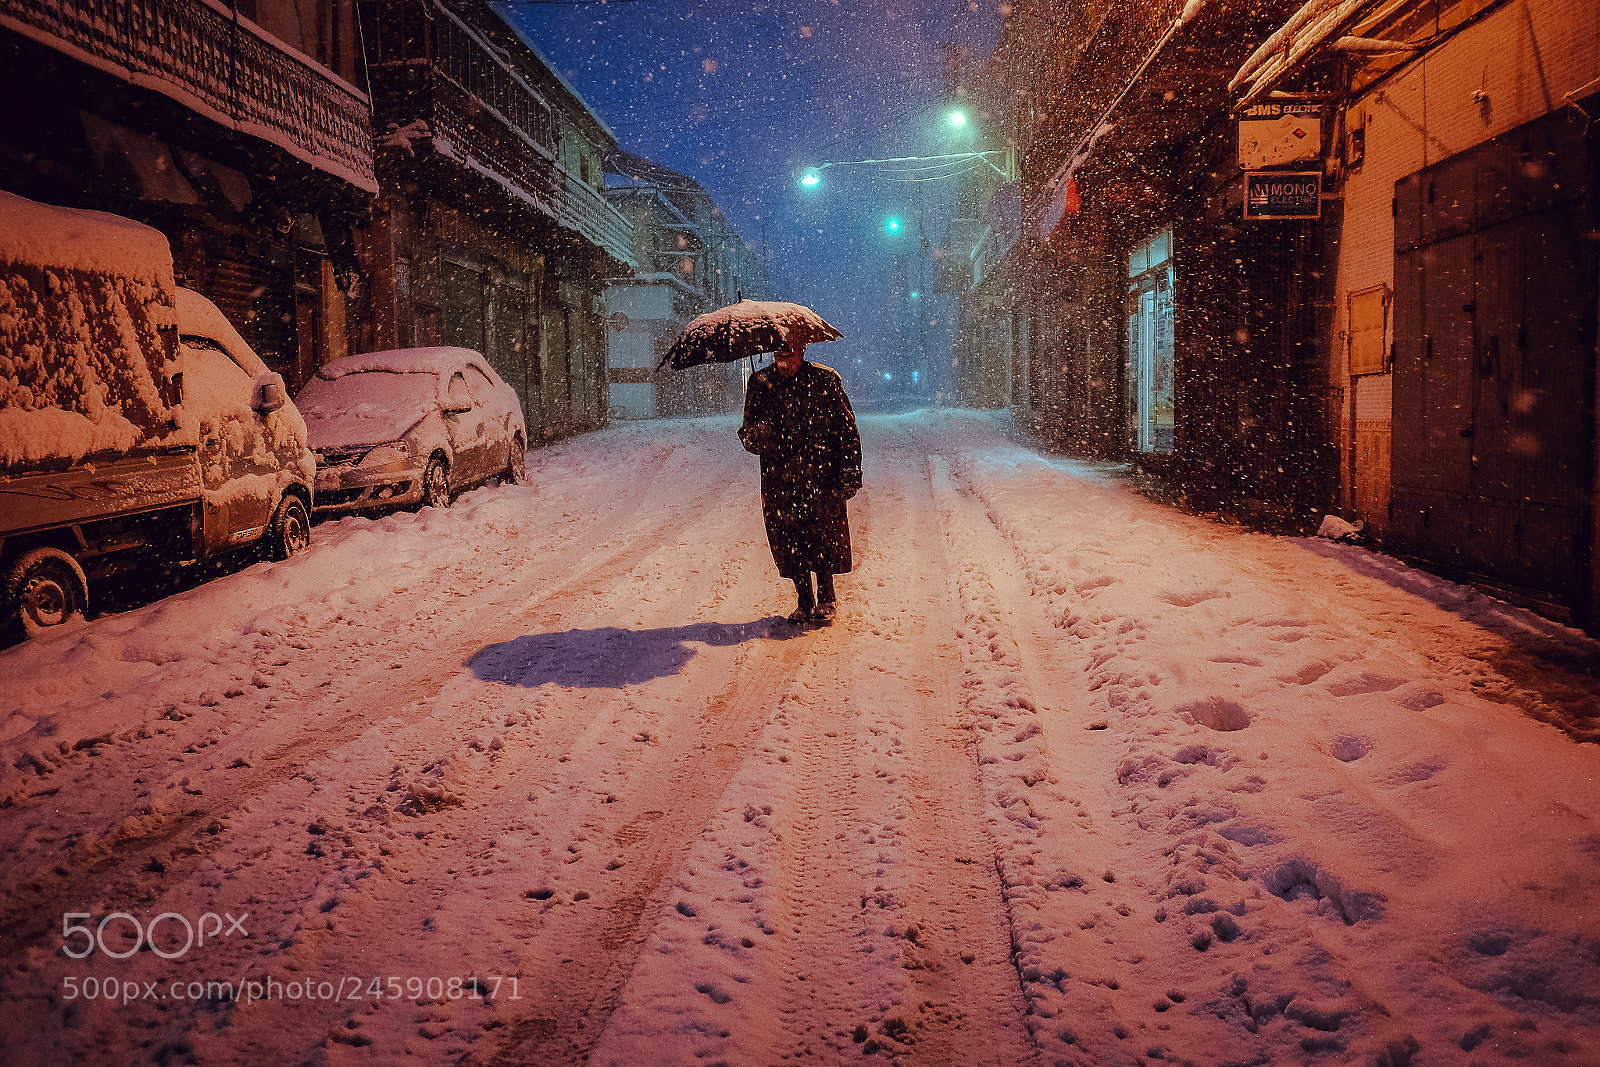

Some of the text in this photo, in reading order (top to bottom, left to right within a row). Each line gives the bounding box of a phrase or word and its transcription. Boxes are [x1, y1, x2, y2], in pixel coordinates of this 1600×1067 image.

[1247, 104, 1281, 116] BMS
[1270, 183, 1317, 196] MONO
[1270, 195, 1317, 204] ELECTRIC
